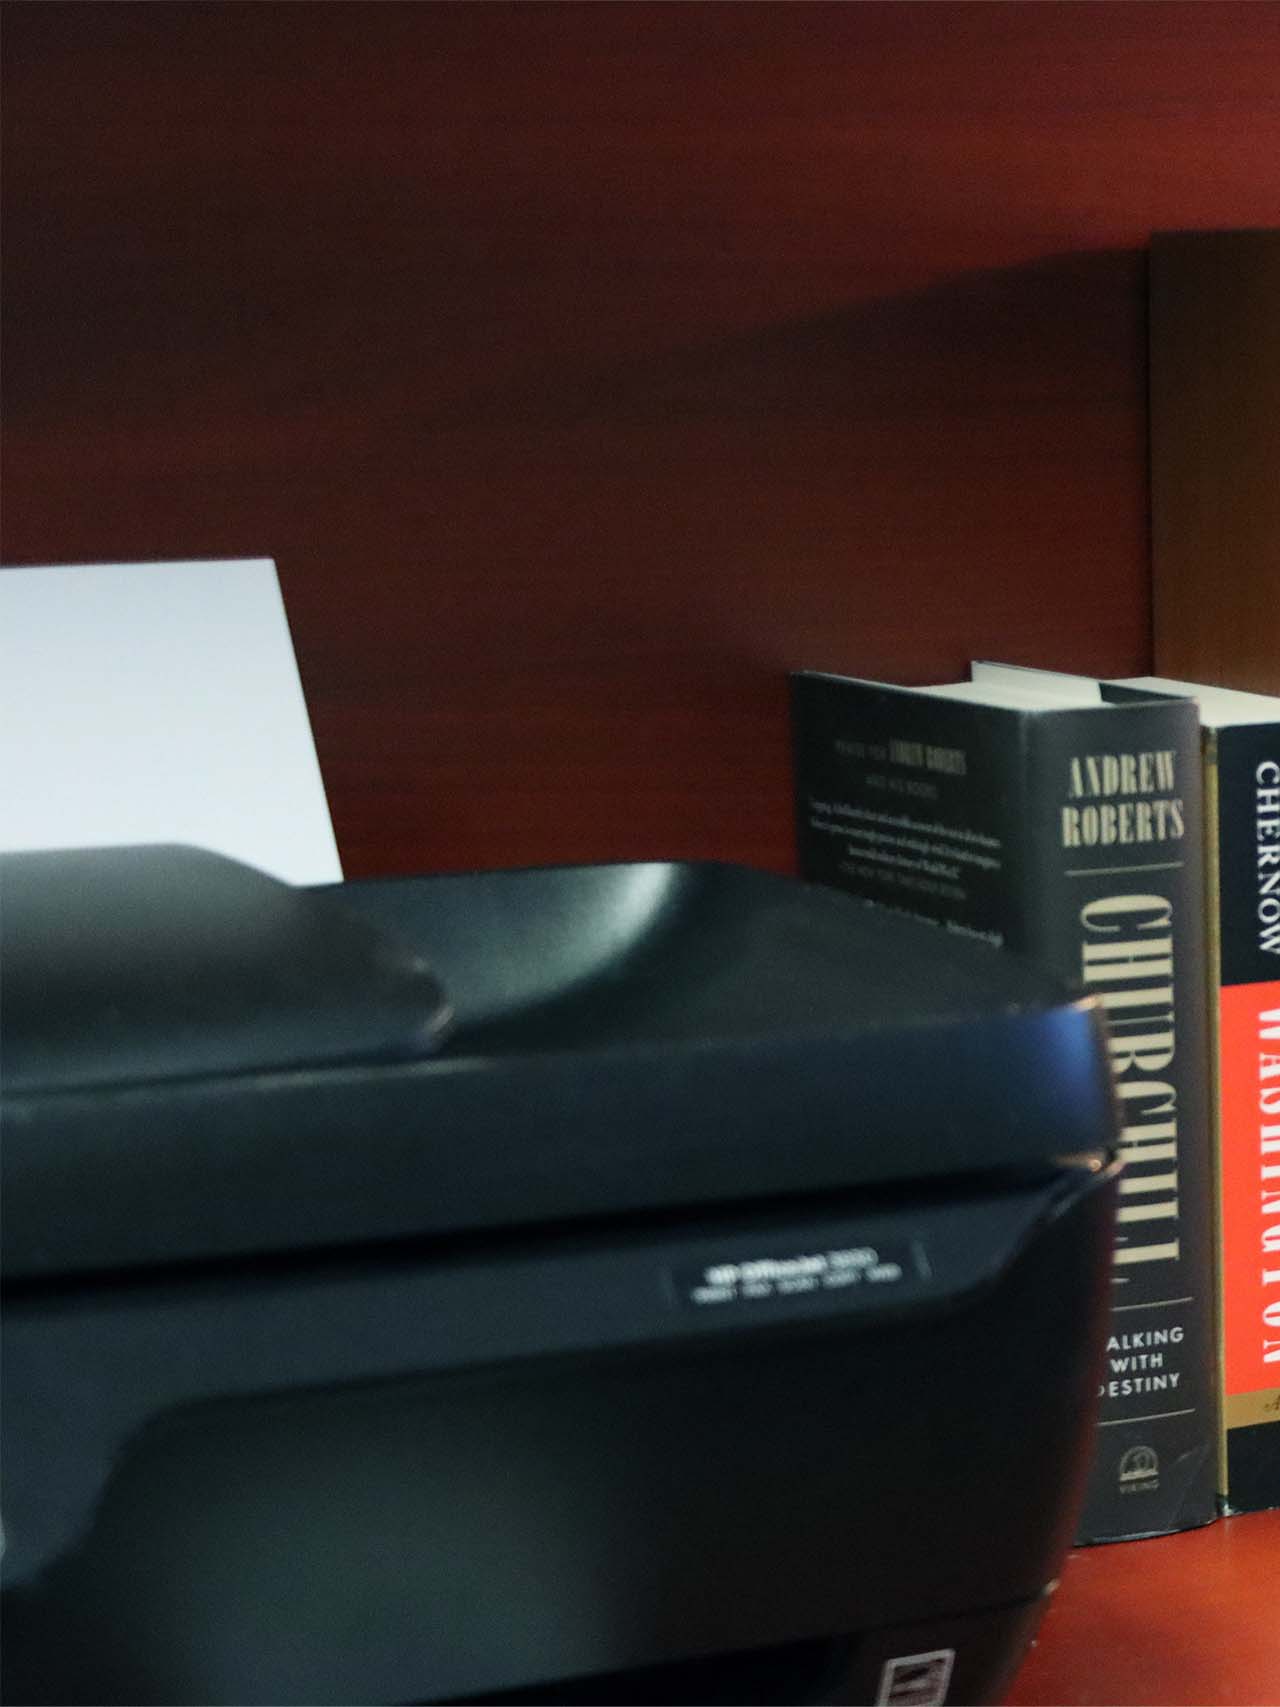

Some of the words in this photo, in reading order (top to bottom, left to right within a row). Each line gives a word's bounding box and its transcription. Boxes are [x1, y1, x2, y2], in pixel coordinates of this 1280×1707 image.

[1068, 749, 1177, 798] ANDREW
[1061, 799, 1184, 848] ROBERTS
[1105, 1325, 1185, 1353] ALKING
[1109, 1352, 1164, 1374] WITH
